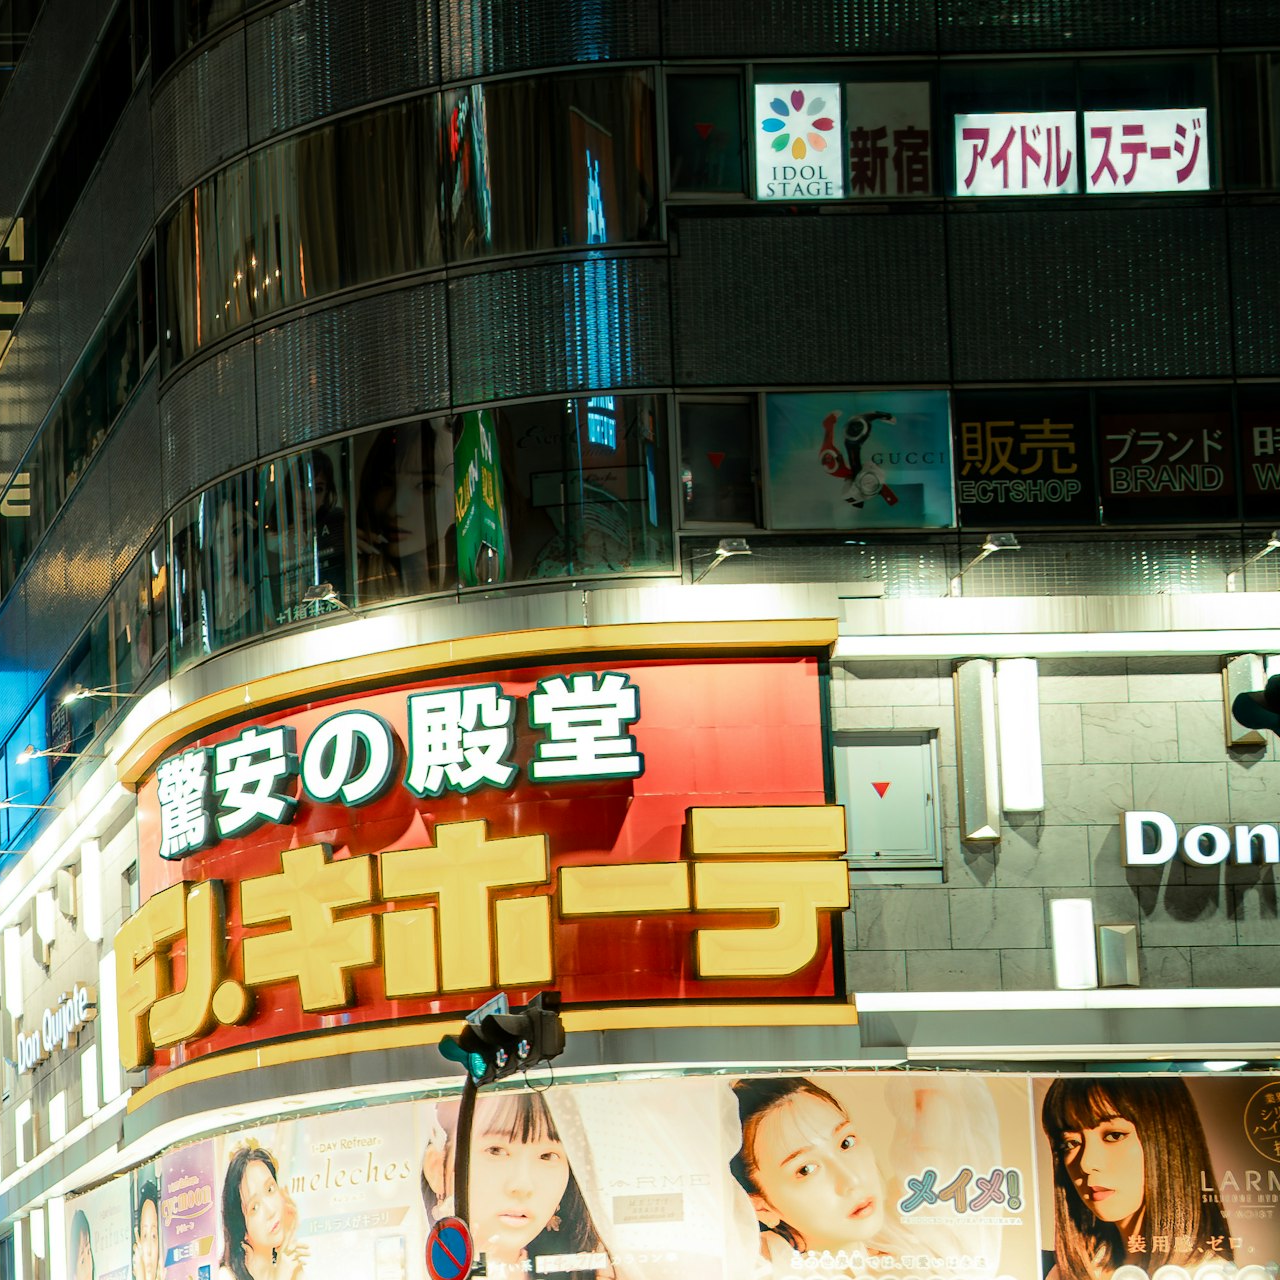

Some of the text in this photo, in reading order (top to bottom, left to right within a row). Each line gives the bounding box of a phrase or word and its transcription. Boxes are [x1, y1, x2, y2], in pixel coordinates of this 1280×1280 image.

[771, 165, 829, 180] IDOL
[850, 126, 931, 195] 新宿
[961, 118, 1202, 190] アイドル ステージ
[766, 181, 834, 197] STAGE
[871, 452, 945, 466] GUCCI
[961, 418, 1077, 476] 販売
[1106, 428, 1224, 464] ブランド
[1110, 464, 1224, 495] BRAND
[156, 670, 645, 861] 驚安の殿堂
[17, 983, 90, 1075] Don Quijote
[291, 1152, 411, 1195] meleches
